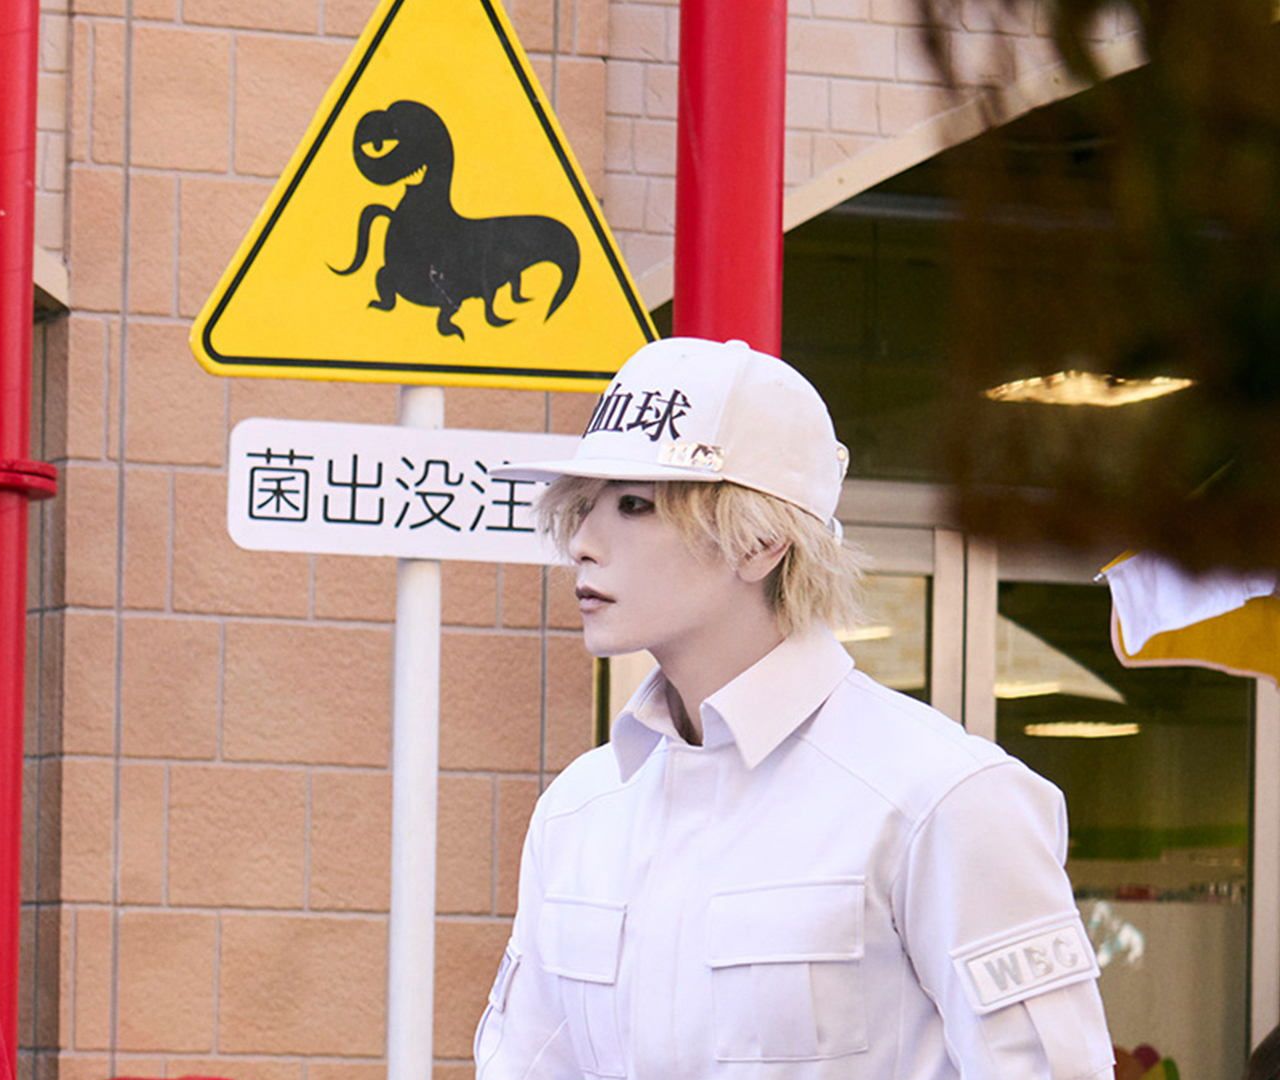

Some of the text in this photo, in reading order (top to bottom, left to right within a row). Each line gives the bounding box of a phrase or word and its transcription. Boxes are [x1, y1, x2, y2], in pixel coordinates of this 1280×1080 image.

[582, 382, 692, 442] 血球
[246, 447, 540, 535] 菌出没注
[983, 936, 1079, 991] WBC
